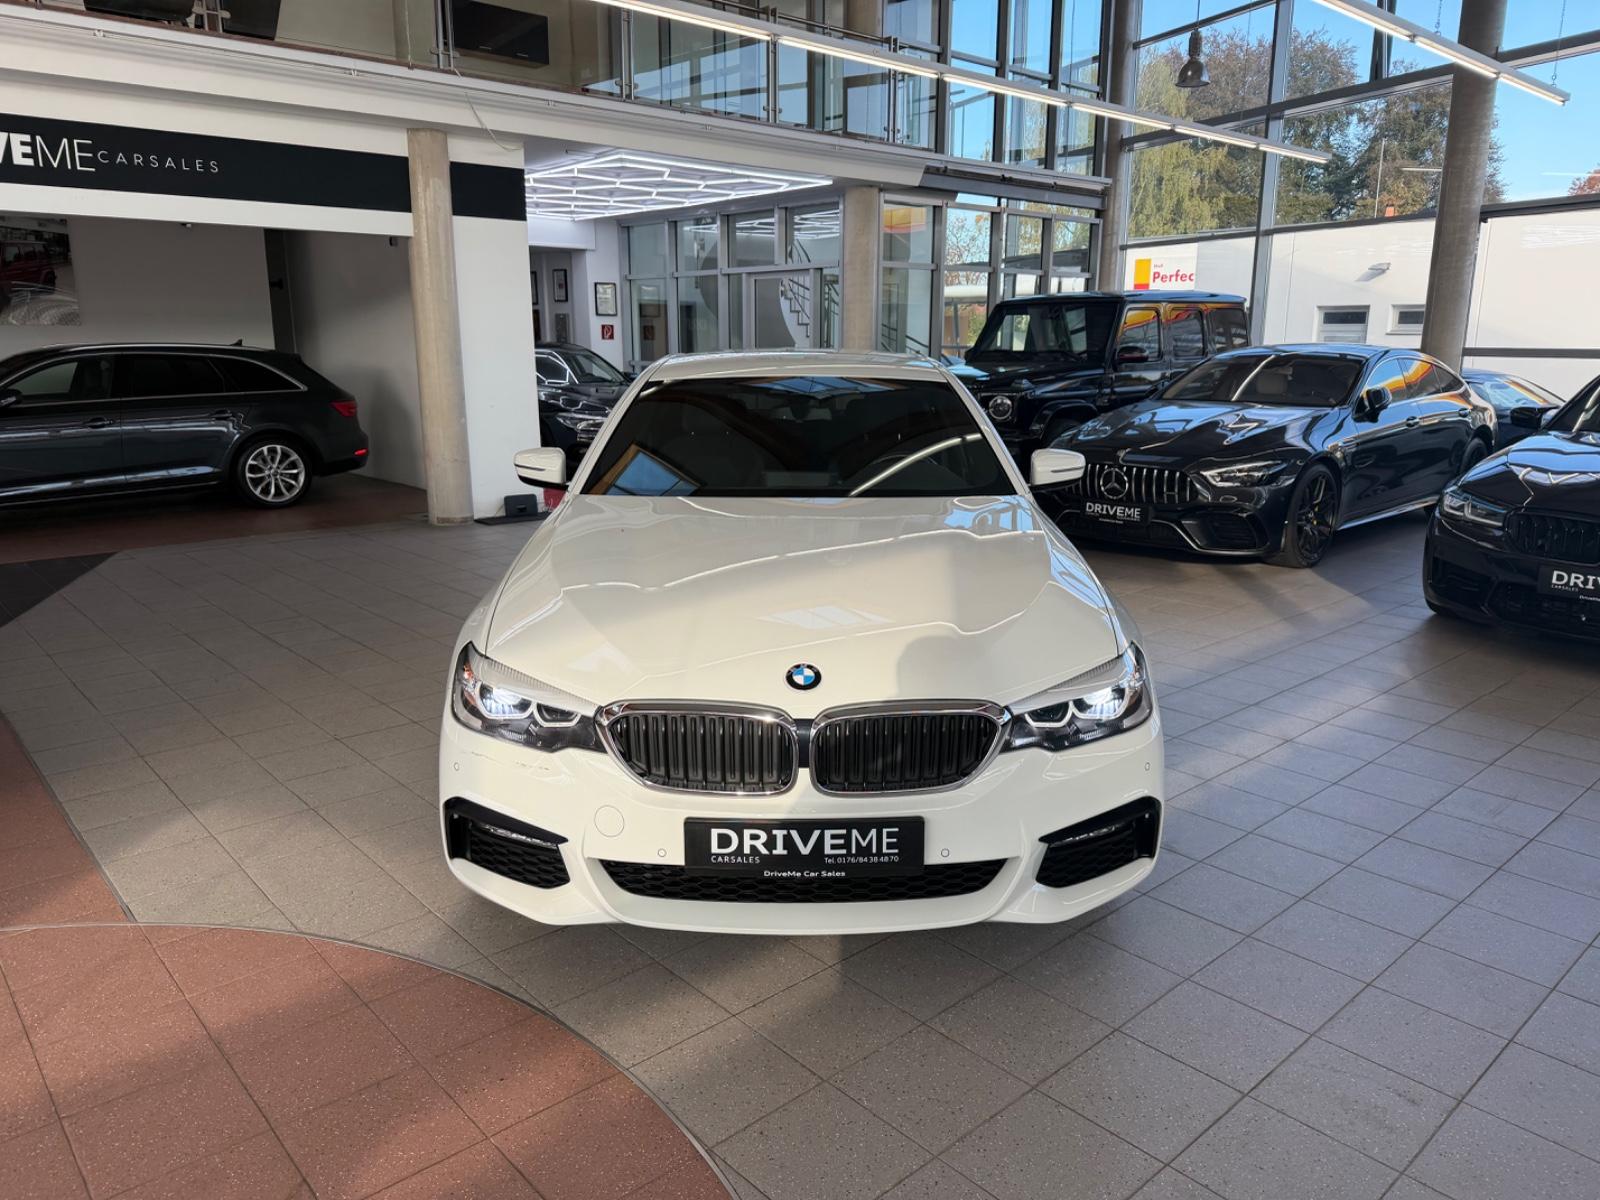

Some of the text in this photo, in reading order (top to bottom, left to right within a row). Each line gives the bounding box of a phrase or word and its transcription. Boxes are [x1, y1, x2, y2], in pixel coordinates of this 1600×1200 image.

[97, 150, 219, 173] CARSALES
[1086, 502, 1141, 518] DRIVEME
[1551, 570, 1600, 590] DRI
[711, 828, 900, 855] DRIVEME
[711, 855, 761, 864] CARSALES
[763, 870, 846, 878] DriveMe Car Sales
